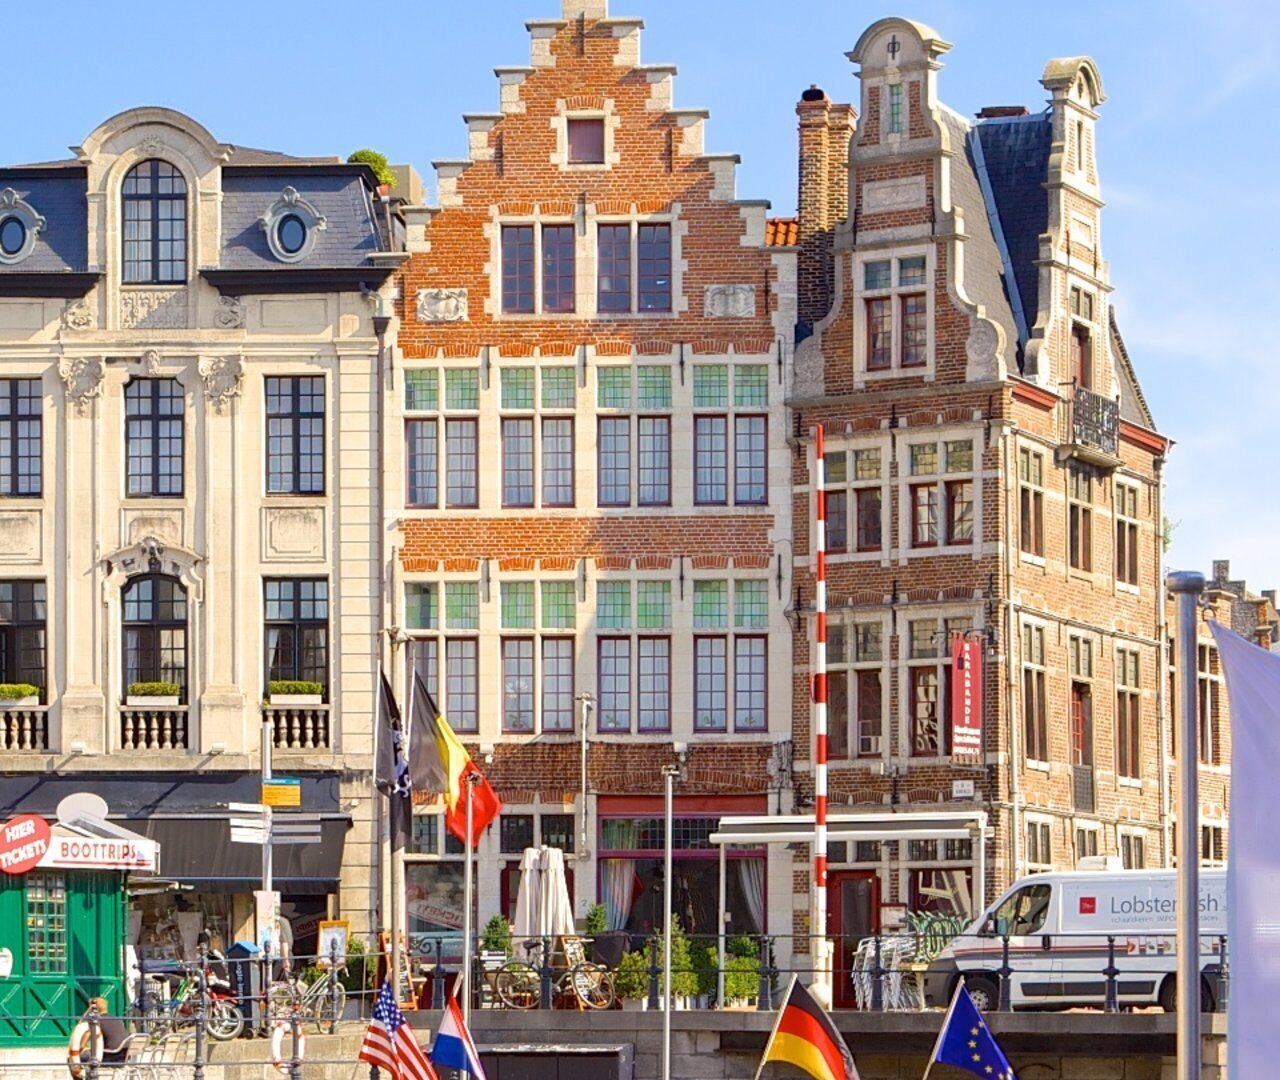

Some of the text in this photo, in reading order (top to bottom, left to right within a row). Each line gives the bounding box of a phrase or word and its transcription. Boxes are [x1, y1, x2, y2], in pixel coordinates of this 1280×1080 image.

[963, 642, 972, 725] SARABANDE
[4, 819, 35, 843] HIER
[60, 841, 137, 860] BOOTTRIPS
[1111, 893, 1218, 914] Lobstersh
